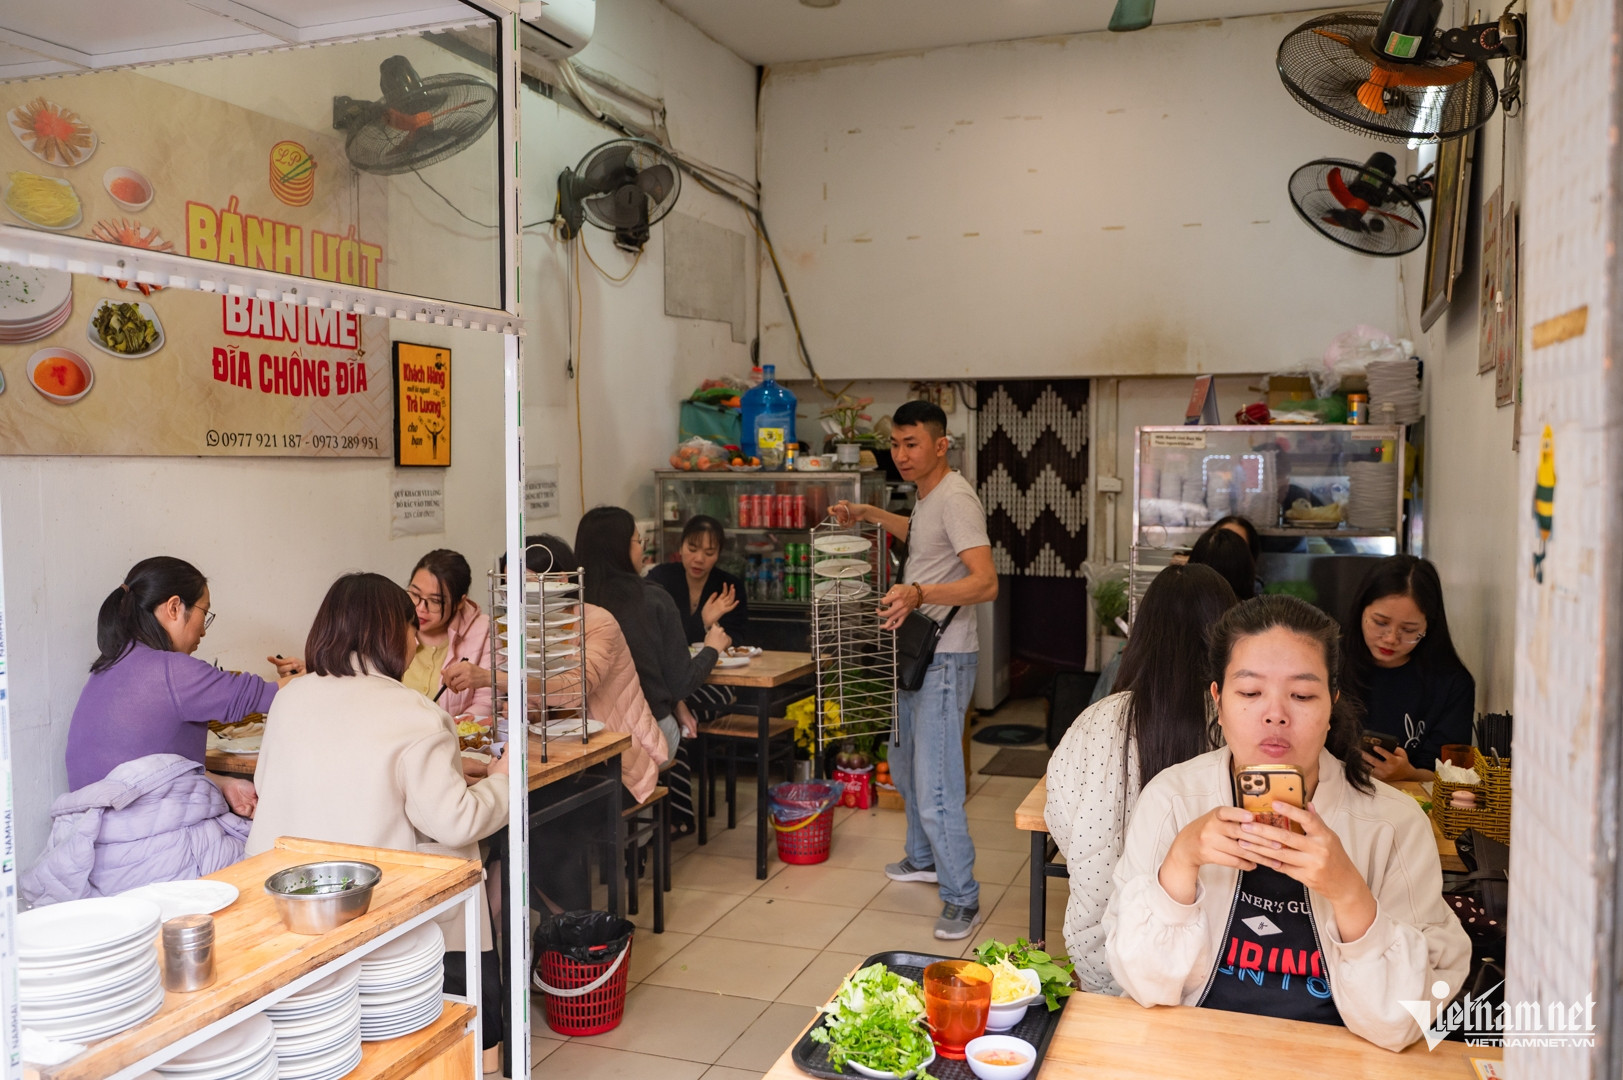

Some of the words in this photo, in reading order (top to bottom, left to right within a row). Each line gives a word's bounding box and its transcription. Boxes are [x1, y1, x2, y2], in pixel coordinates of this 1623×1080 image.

[186, 195, 303, 275] BÁNH
[212, 344, 252, 390] ĐĨA
[335, 357, 368, 396] ĐĨA
[221, 432, 252, 448] 0977
[256, 433, 278, 448] 921
[283, 434, 302, 448] 187
[312, 435, 339, 449] 0973
[341, 435, 360, 449] 289
[361, 436, 379, 450] 951
[4, 809, 14, 855] NAMHAI
